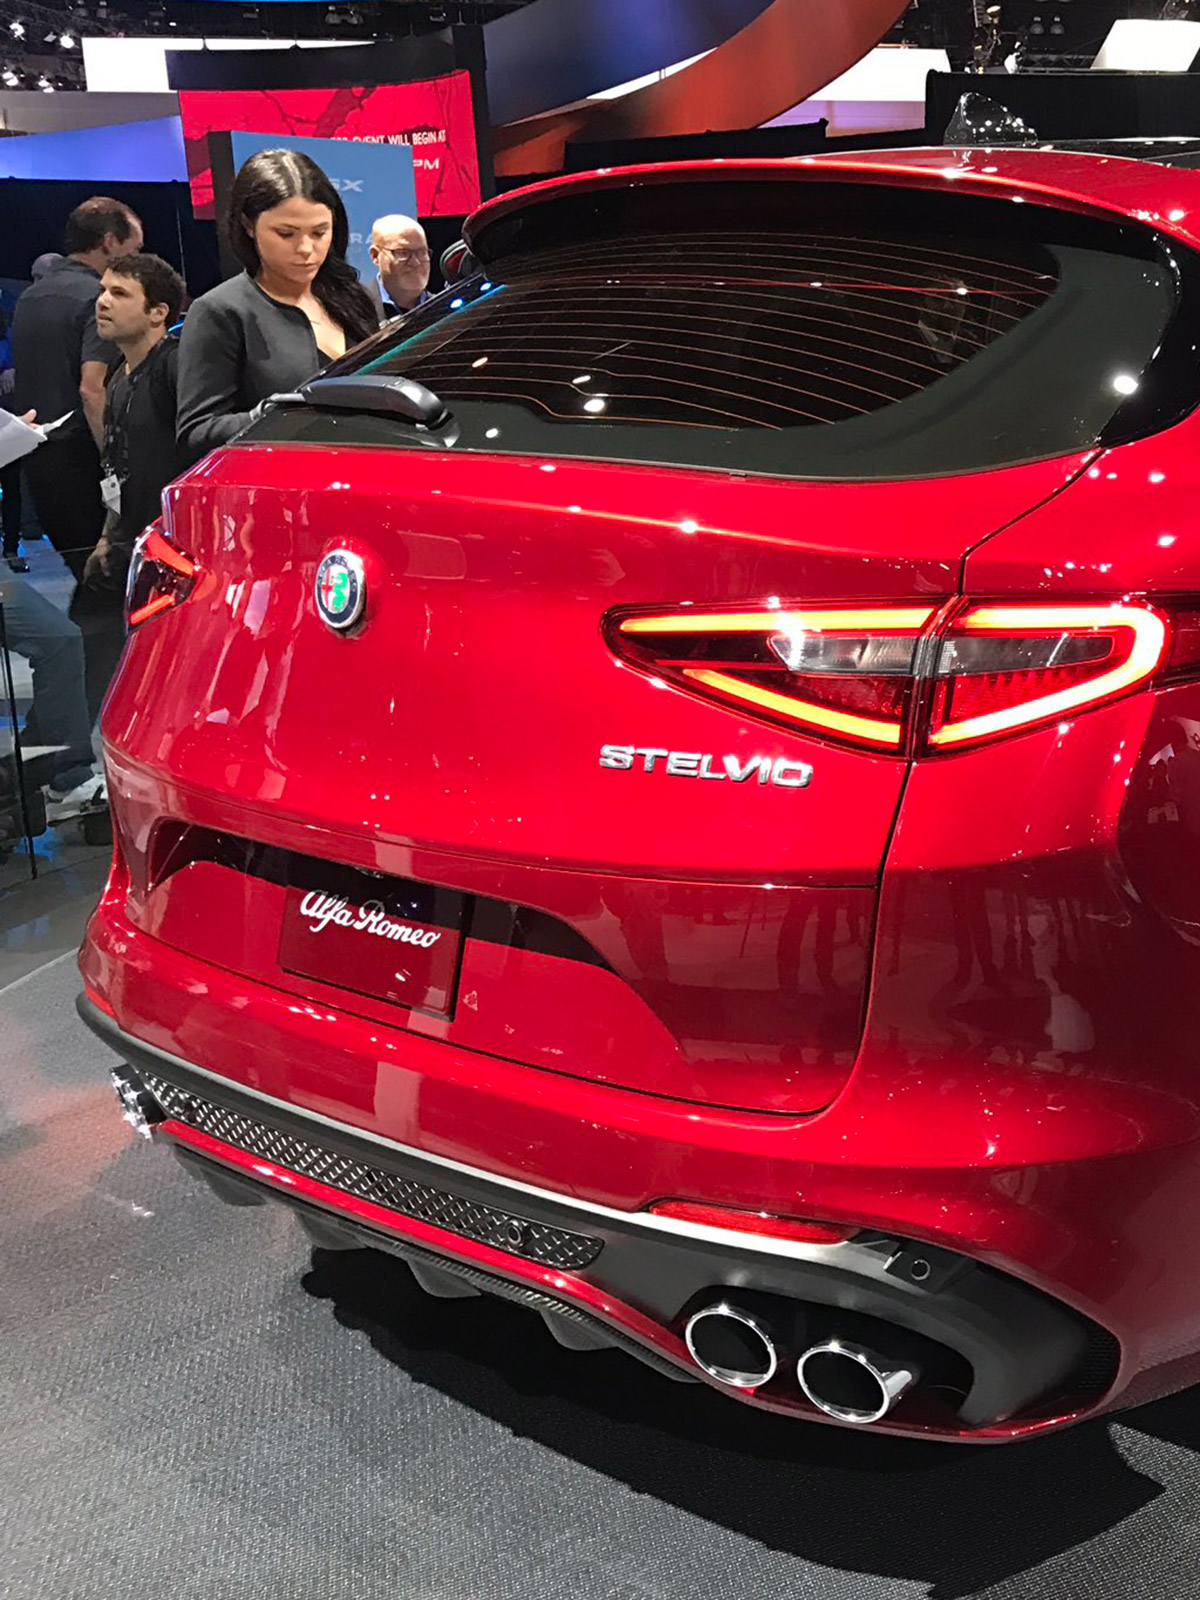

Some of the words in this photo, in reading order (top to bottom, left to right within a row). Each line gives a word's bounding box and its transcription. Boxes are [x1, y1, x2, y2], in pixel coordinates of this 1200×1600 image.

[388, 133, 410, 146] WILL
[412, 133, 437, 146] BEGIN
[438, 130, 446, 142] AT
[413, 158, 439, 170] PM
[599, 745, 813, 787] STELVIO
[300, 889, 355, 932] Alfa
[353, 900, 441, 948] Romeo
